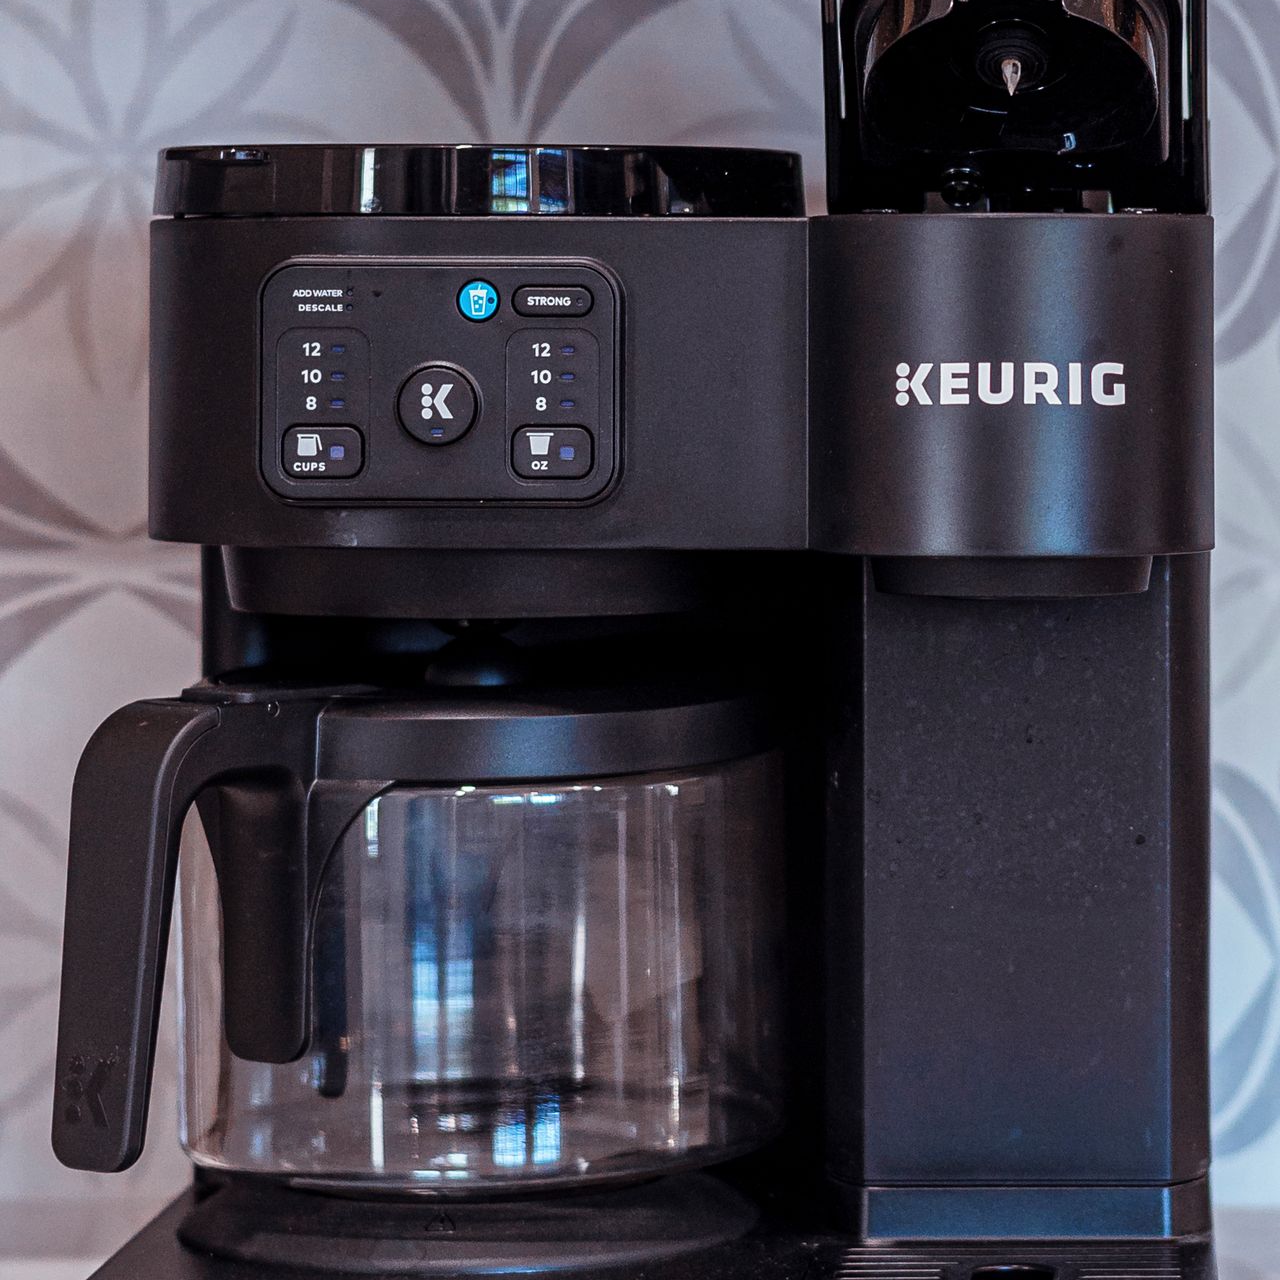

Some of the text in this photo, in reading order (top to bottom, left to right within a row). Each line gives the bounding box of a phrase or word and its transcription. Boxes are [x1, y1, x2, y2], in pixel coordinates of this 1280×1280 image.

[293, 289, 343, 298] ADD WATER
[298, 303, 343, 312] DESCALE
[527, 296, 571, 307] STRONG
[302, 343, 321, 357] 12
[532, 343, 551, 357] 12
[301, 370, 322, 384] 10
[531, 370, 552, 384] 10
[895, 361, 1126, 407] KEURIG
[305, 396, 317, 411] 8
[535, 397, 547, 411] 8
[293, 461, 326, 472] CUPS
[531, 461, 548, 471] OZ
